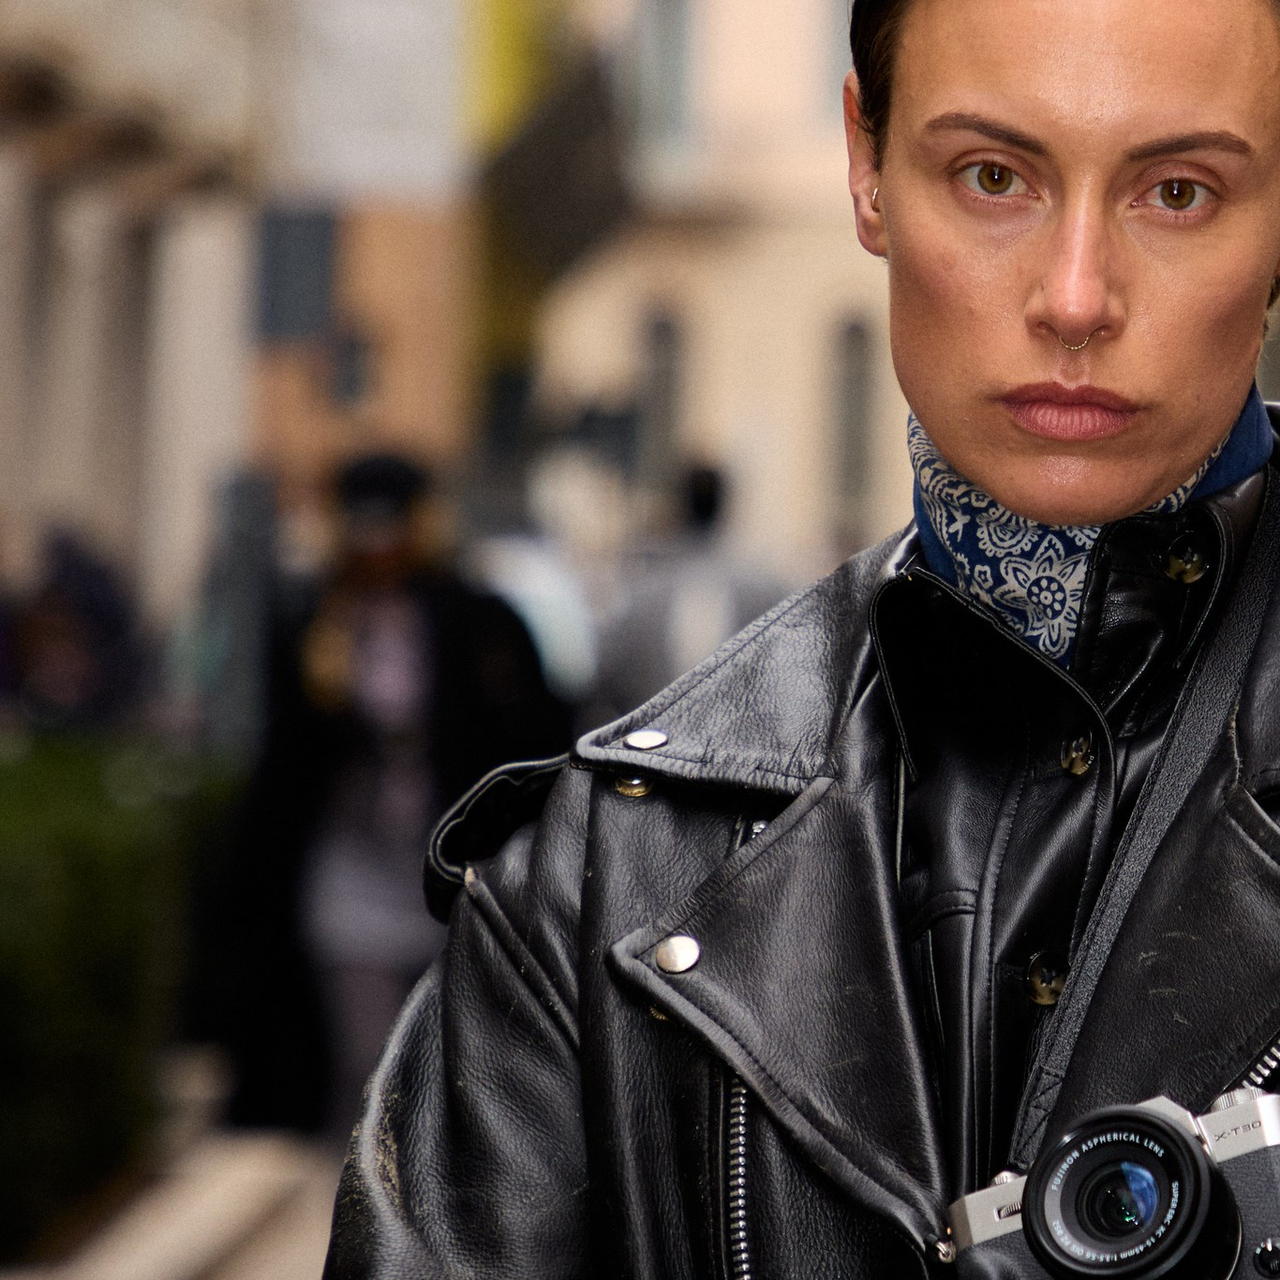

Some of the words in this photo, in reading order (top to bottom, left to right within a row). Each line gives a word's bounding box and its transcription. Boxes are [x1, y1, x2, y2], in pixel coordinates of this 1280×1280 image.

[1213, 1120, 1262, 1142] X-T30
[1051, 1149, 1080, 1191] FUJINON
[1081, 1131, 1141, 1153] ASPHERICAL
[1143, 1137, 1165, 1158] LENS
[1170, 1180, 1179, 1208] SUPER
